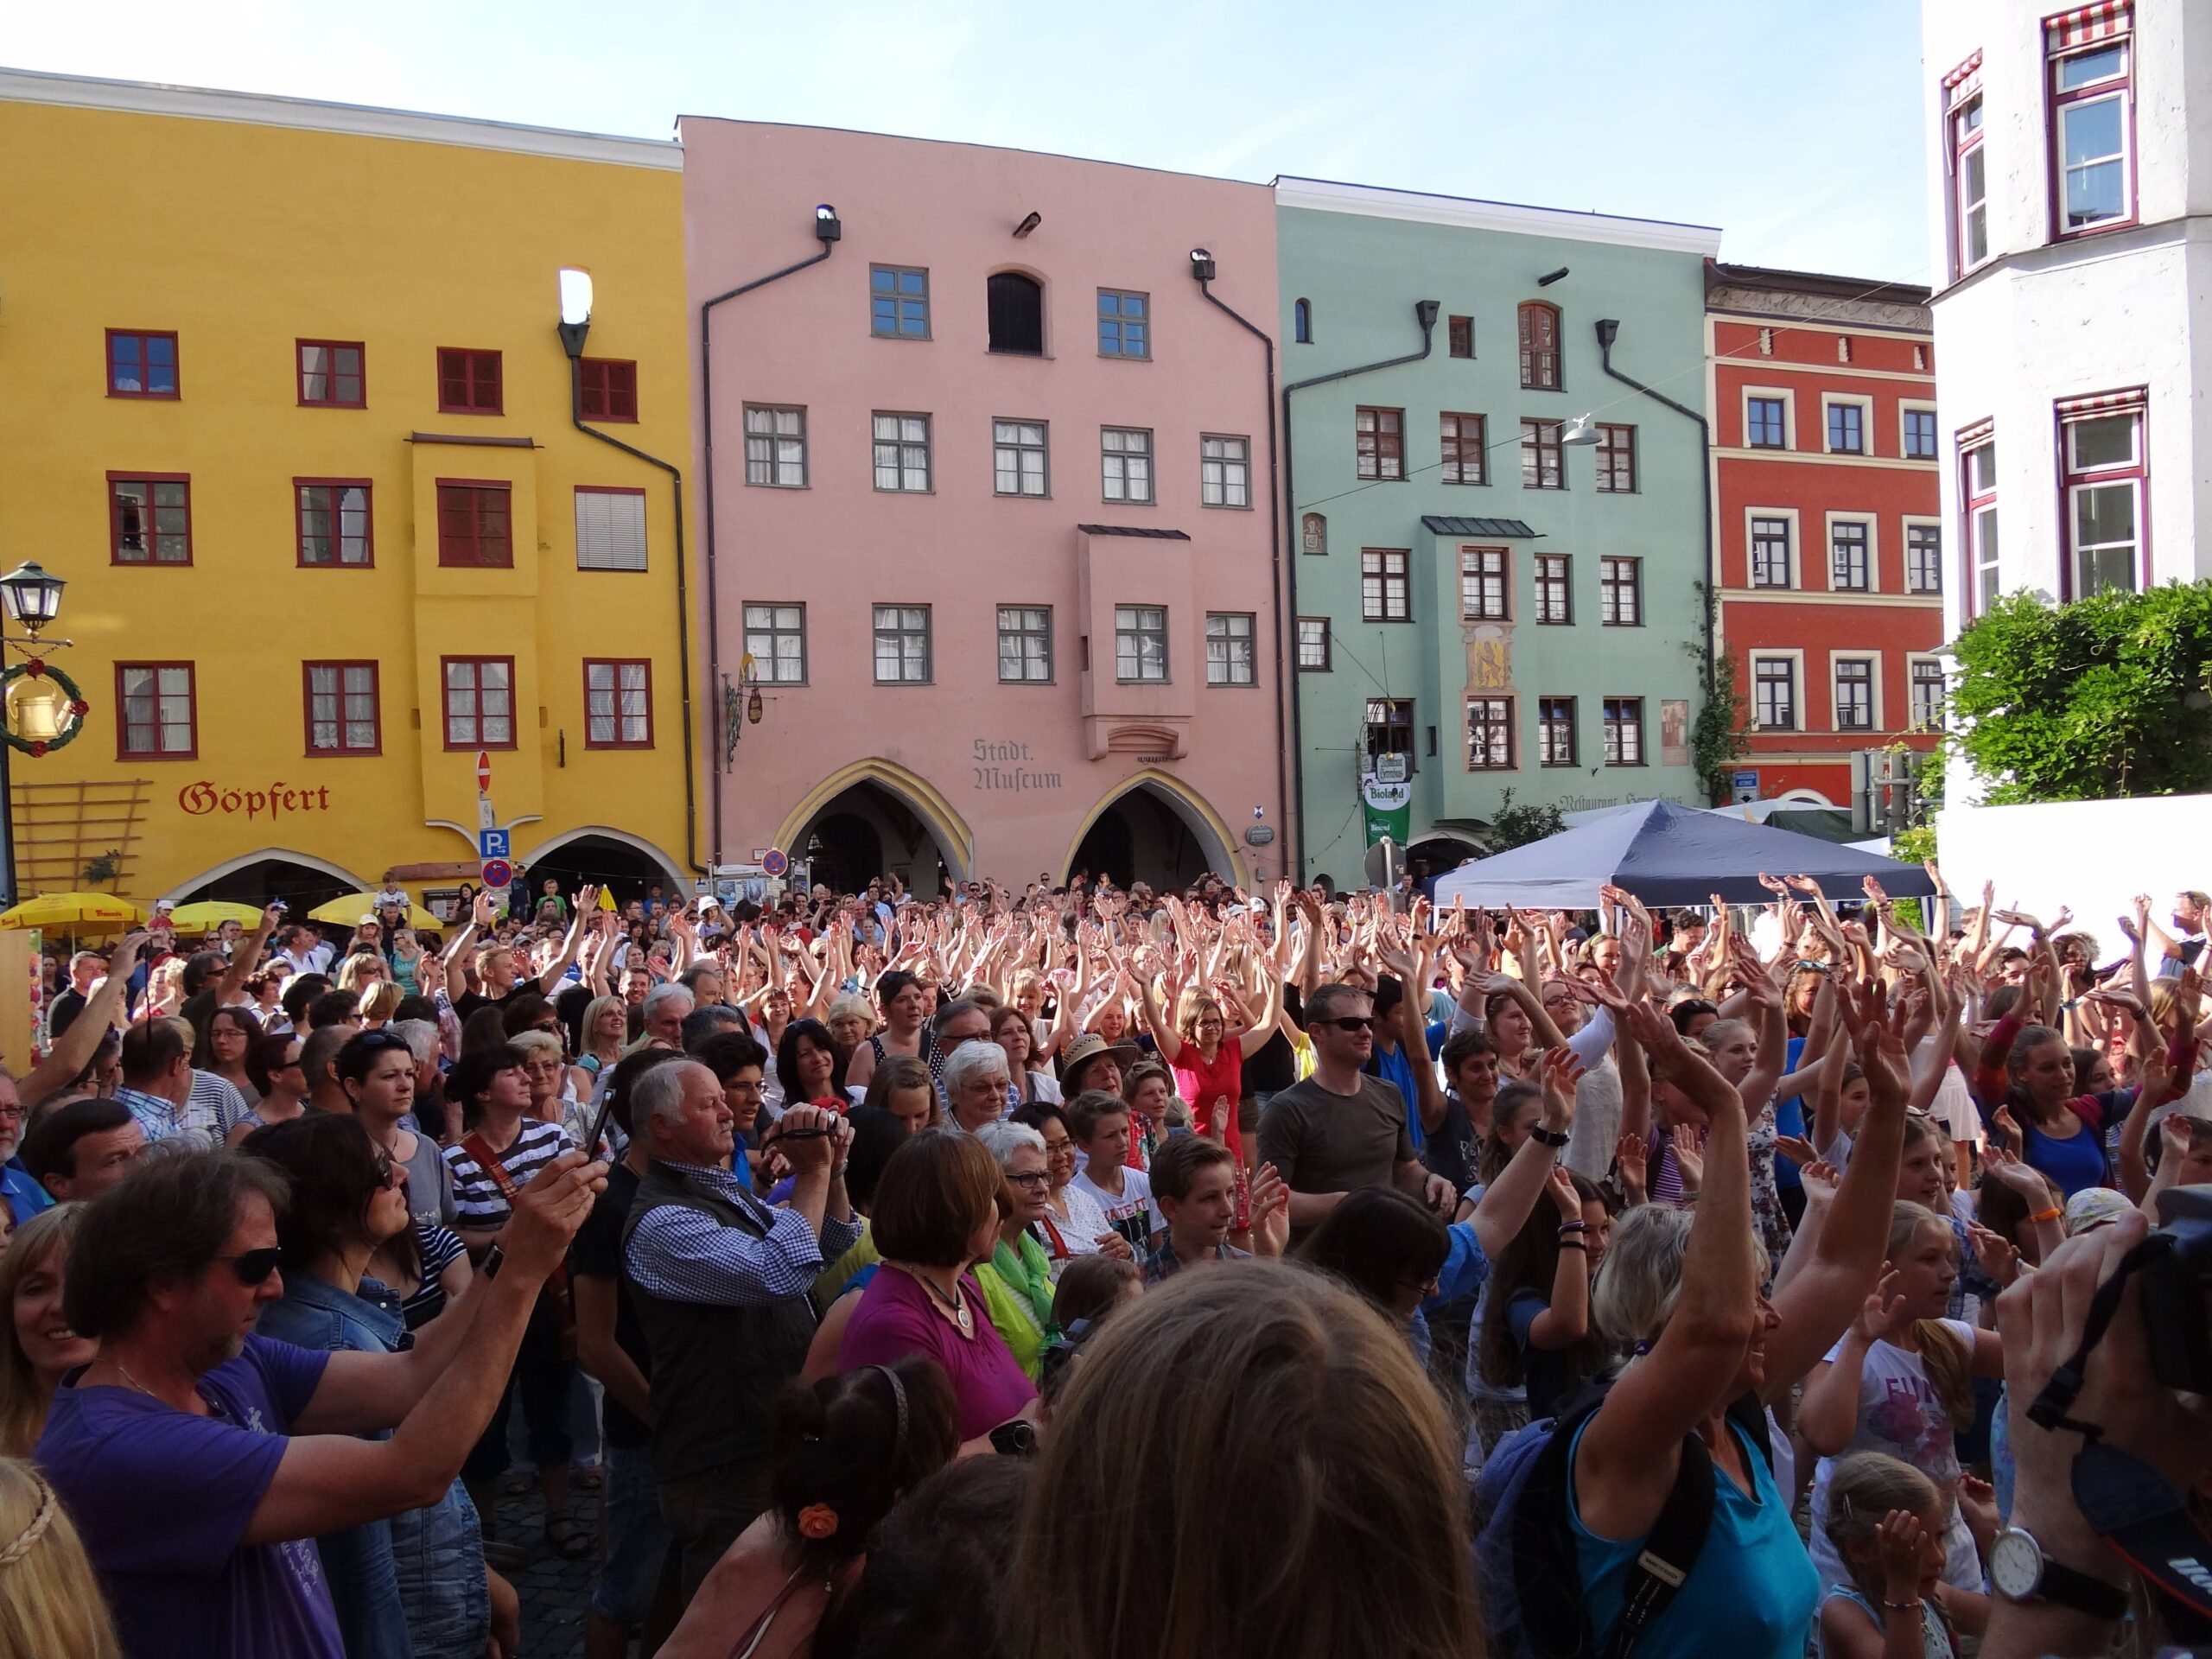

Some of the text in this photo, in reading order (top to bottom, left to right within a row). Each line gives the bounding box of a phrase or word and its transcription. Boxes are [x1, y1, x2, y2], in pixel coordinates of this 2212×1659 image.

[973, 739, 1034, 762] Städt.
[179, 780, 330, 822] Göpfert
[1370, 787, 1404, 799] Biolad
[486, 833, 503, 855] P
